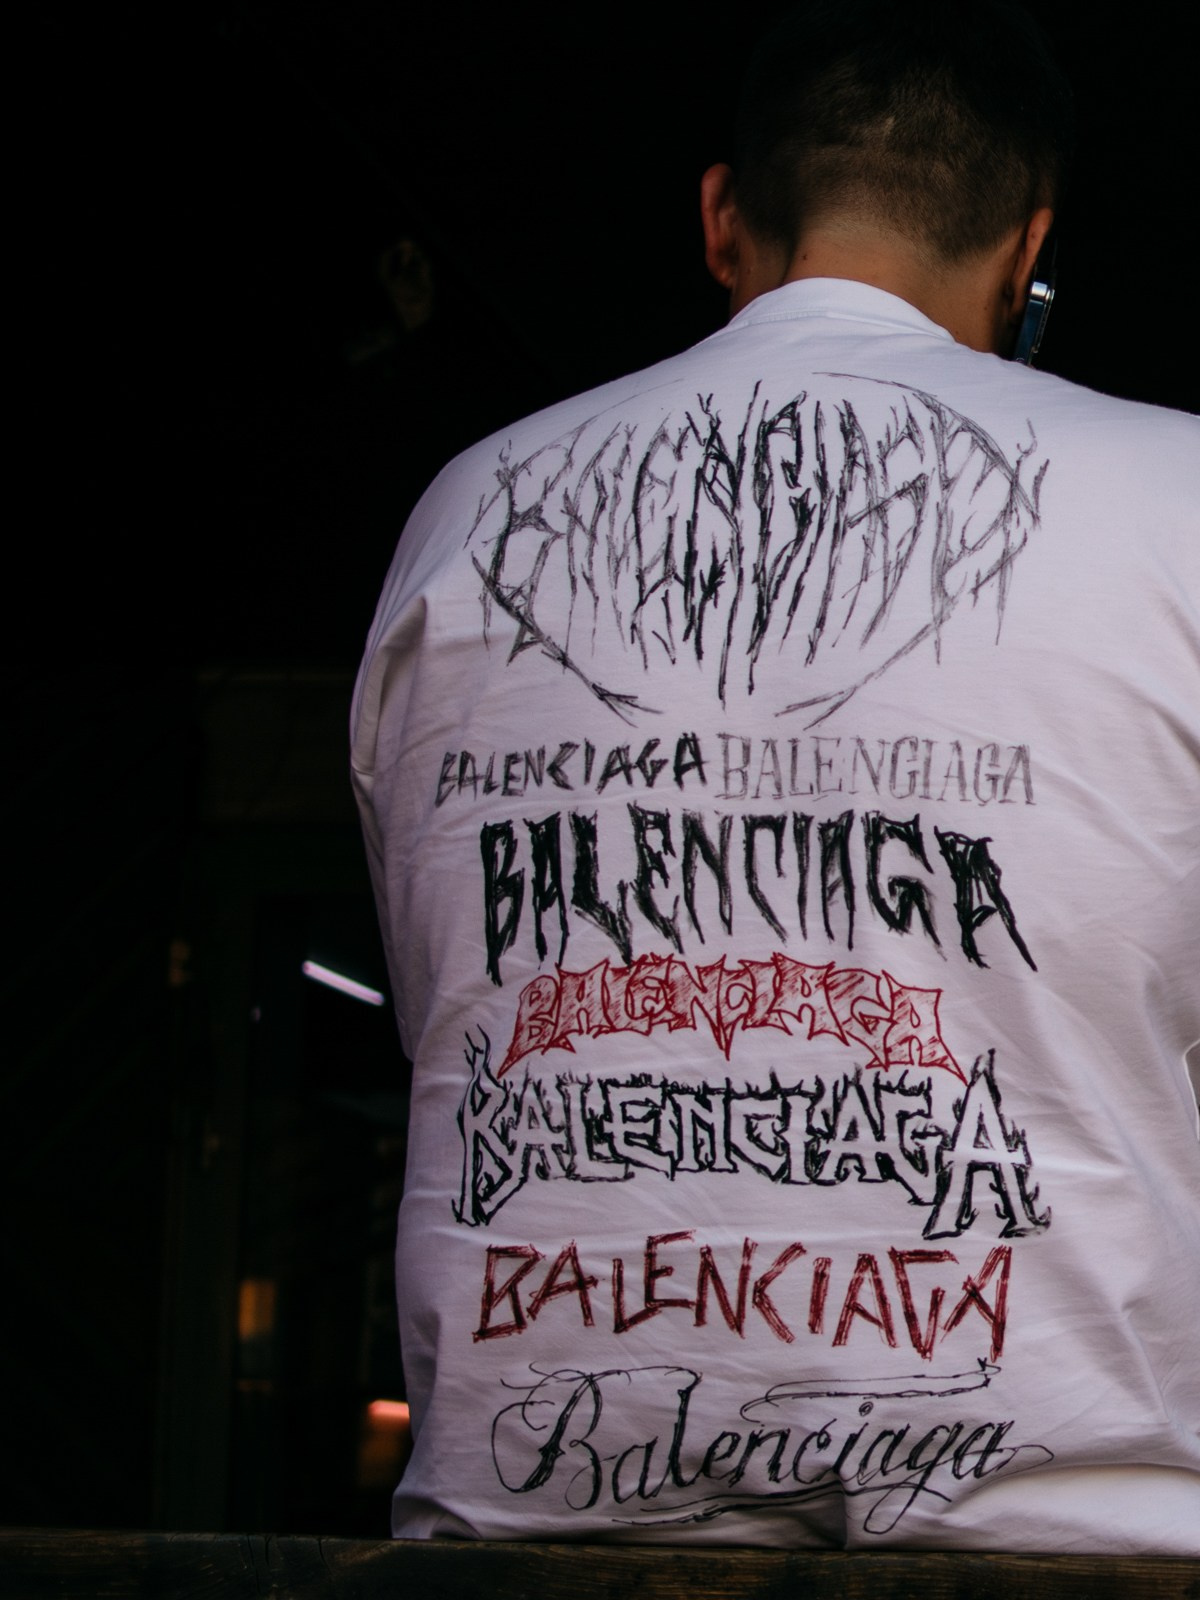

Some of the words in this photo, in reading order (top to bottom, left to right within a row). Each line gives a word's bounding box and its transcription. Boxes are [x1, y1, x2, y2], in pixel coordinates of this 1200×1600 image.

[435, 732, 708, 808] BALENCIAGA
[480, 801, 1038, 986] BALENCIAGA
[497, 952, 968, 1087] BALENCIAGA
[451, 1023, 1053, 1240] BALENCIAGA
[473, 1230, 1013, 1362] BALENCIAGA
[490, 1361, 1054, 1534] Balenciaga
